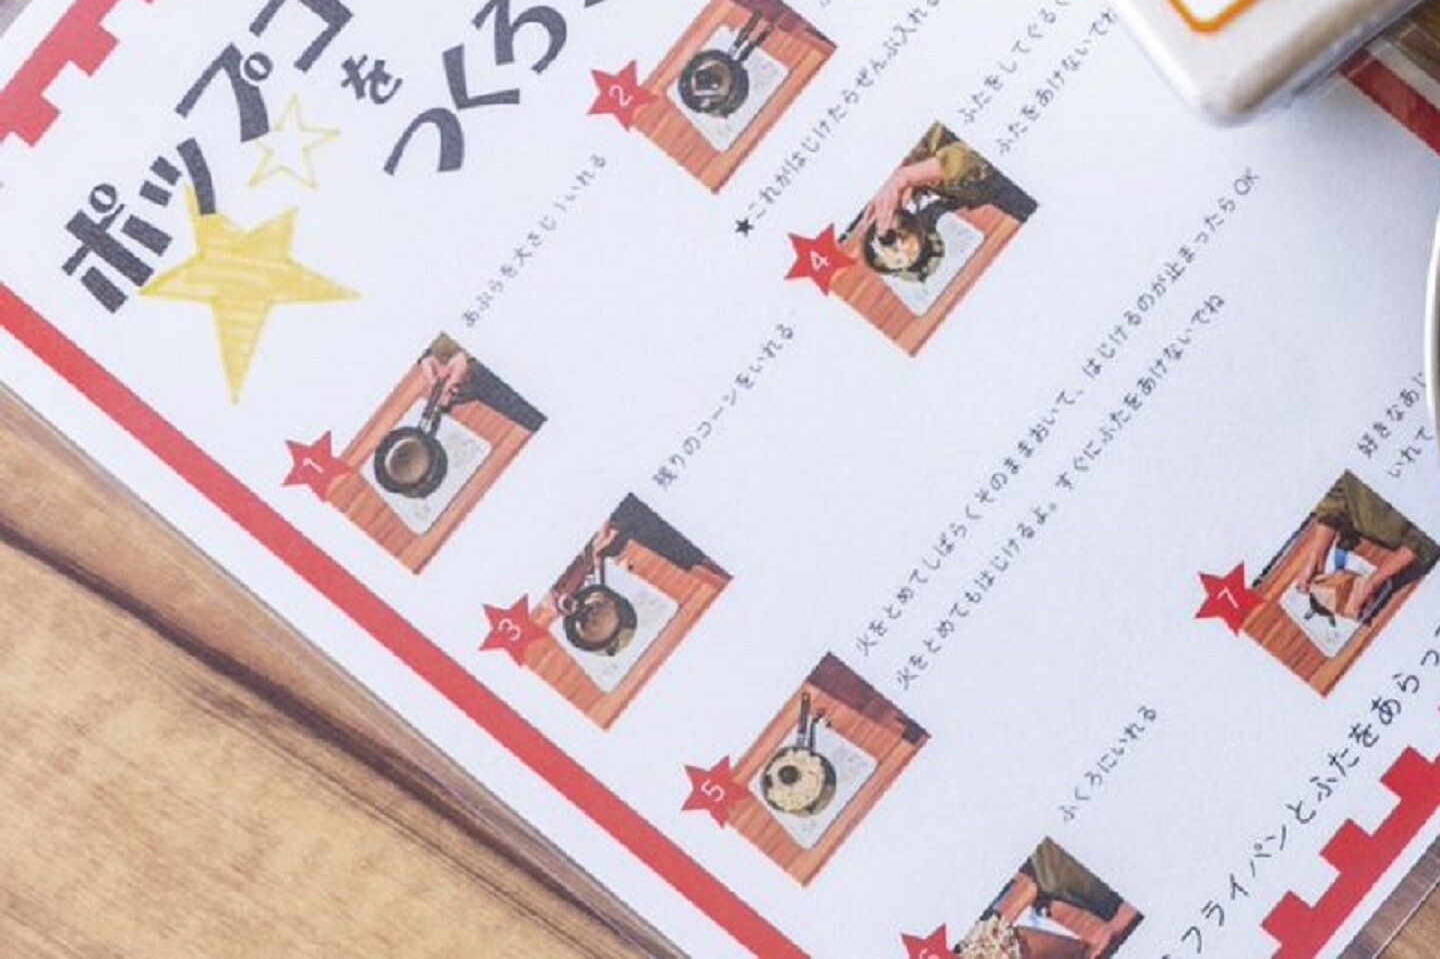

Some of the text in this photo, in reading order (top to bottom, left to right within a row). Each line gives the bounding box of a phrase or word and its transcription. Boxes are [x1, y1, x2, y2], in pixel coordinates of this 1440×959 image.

[341, 52, 403, 105] を
[608, 84, 634, 108] 2
[809, 251, 829, 273] 4
[652, 323, 795, 492] 残りのコーンをいれる
[302, 456, 326, 476] 1
[1216, 588, 1240, 611] 7
[498, 617, 523, 641] 3
[1059, 705, 1158, 823] ふくろにいれる
[702, 779, 727, 802] 5
